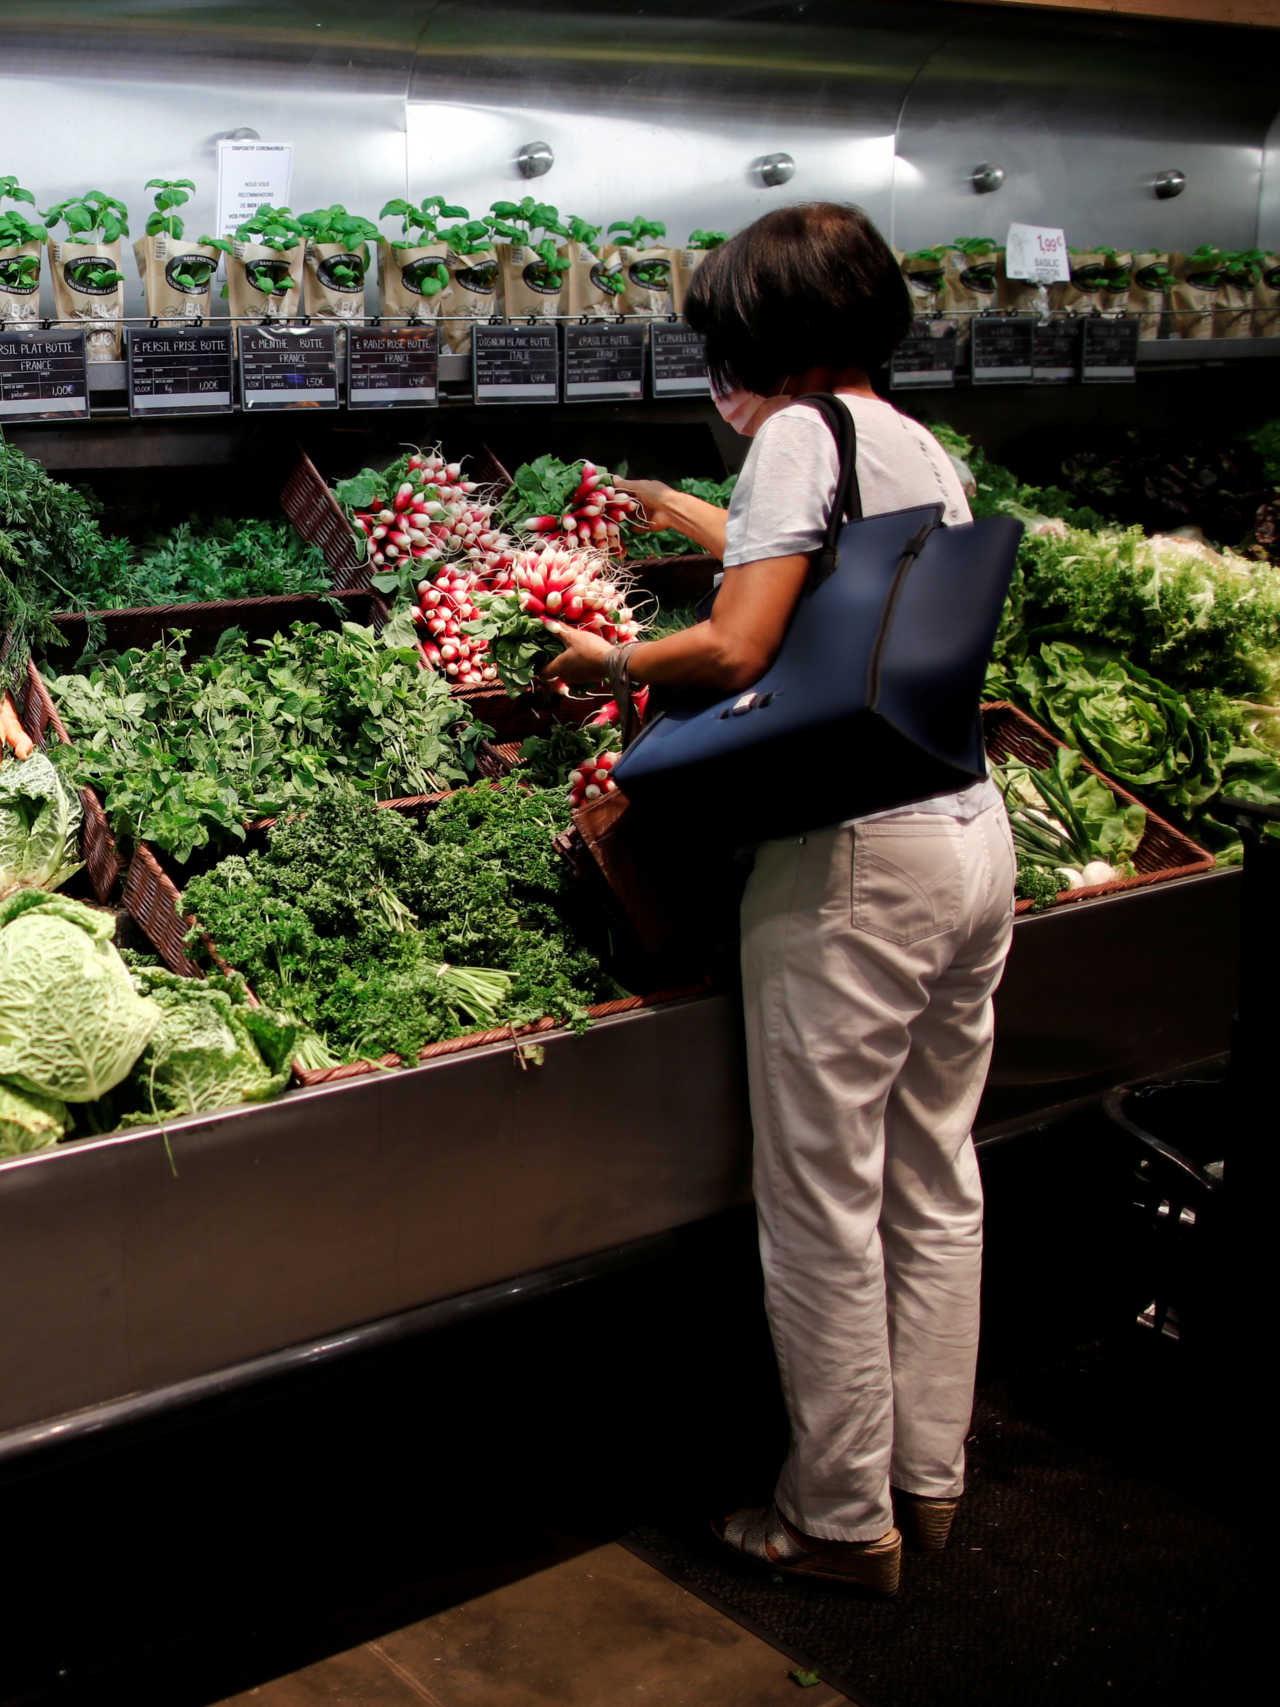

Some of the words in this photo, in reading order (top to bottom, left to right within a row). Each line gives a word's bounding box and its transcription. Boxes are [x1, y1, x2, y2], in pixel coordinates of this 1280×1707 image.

[20, 343, 42, 355] PLAT
[45, 342, 75, 354] BOTTE
[142, 341, 172, 353] PERSIL
[173, 341, 198, 352] FRISE
[200, 340, 227, 352] BOTTE
[258, 338, 288, 349] MENTHE
[300, 338, 325, 349] BOTTE
[363, 339, 385, 350] RADIS
[387, 339, 406, 350] ROSE
[407, 339, 432, 349] BOTTE
[279, 353, 307, 364] FRANCE
[384, 353, 409, 363] FRANCE
[20, 360, 54, 371] FRANCE
[52, 384, 75, 397] 1,00€
